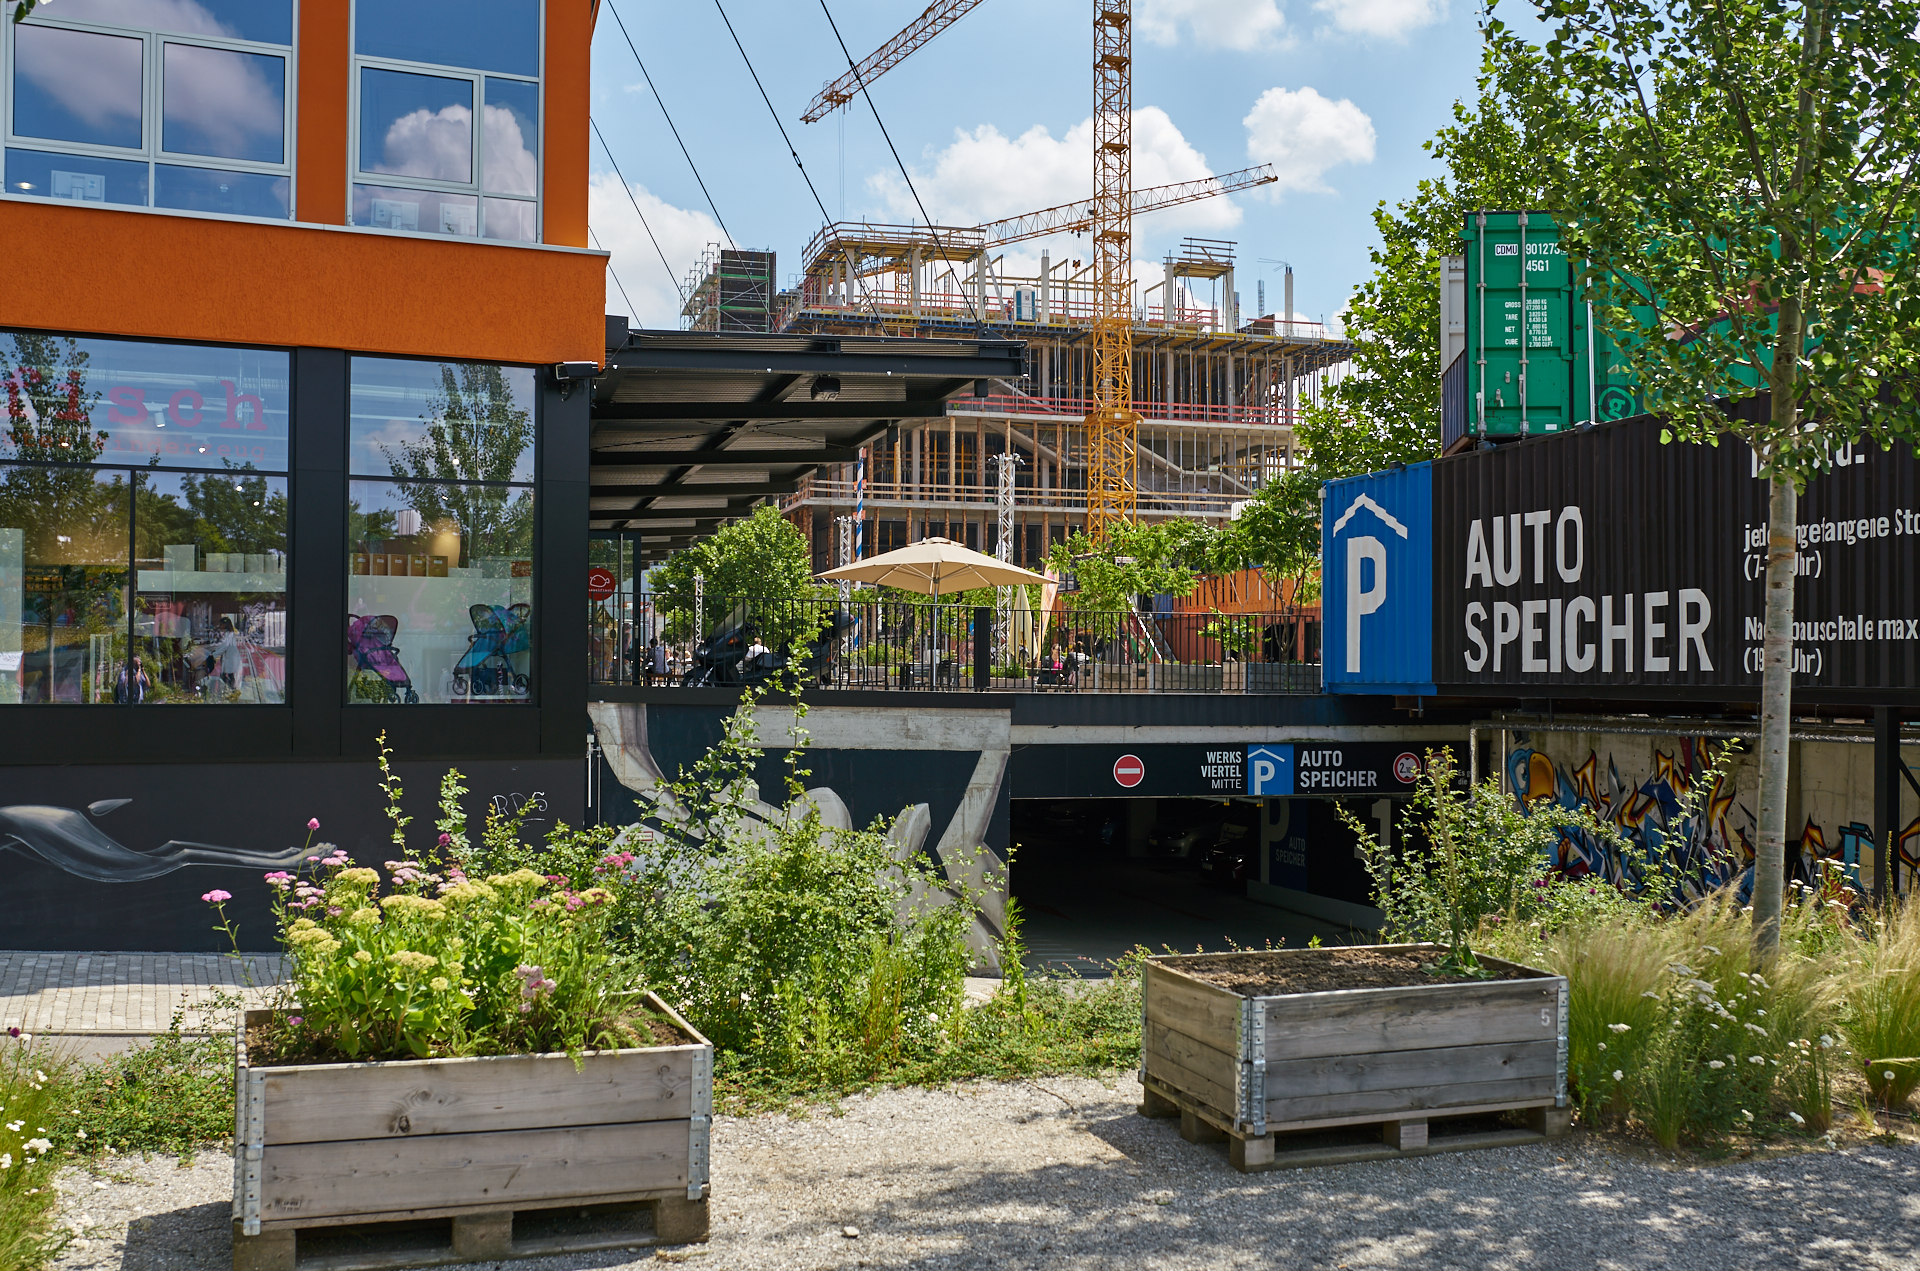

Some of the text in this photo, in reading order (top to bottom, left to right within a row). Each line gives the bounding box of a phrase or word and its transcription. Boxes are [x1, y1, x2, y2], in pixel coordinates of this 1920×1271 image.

[1495, 244, 1518, 255] CDMU
[1525, 260, 1549, 272] 45G1
[1743, 522, 1770, 552] jed
[1795, 516, 1890, 549] ngefangene
[1464, 505, 1584, 589] AUTO
[1346, 535, 1387, 673] P
[1463, 587, 1714, 673] SPEICHER
[1206, 751, 1242, 764] WERKS
[1300, 750, 1343, 767] AUTO
[1200, 765, 1242, 777] VIERTEL
[1254, 760, 1276, 795] P
[1300, 770, 1377, 788] SPEICHER
[1211, 779, 1242, 789] MITTE
[1288, 836, 1306, 851] AUTO
[1275, 850, 1306, 868] SPEICHER
[1541, 1008, 1551, 1027] 5
